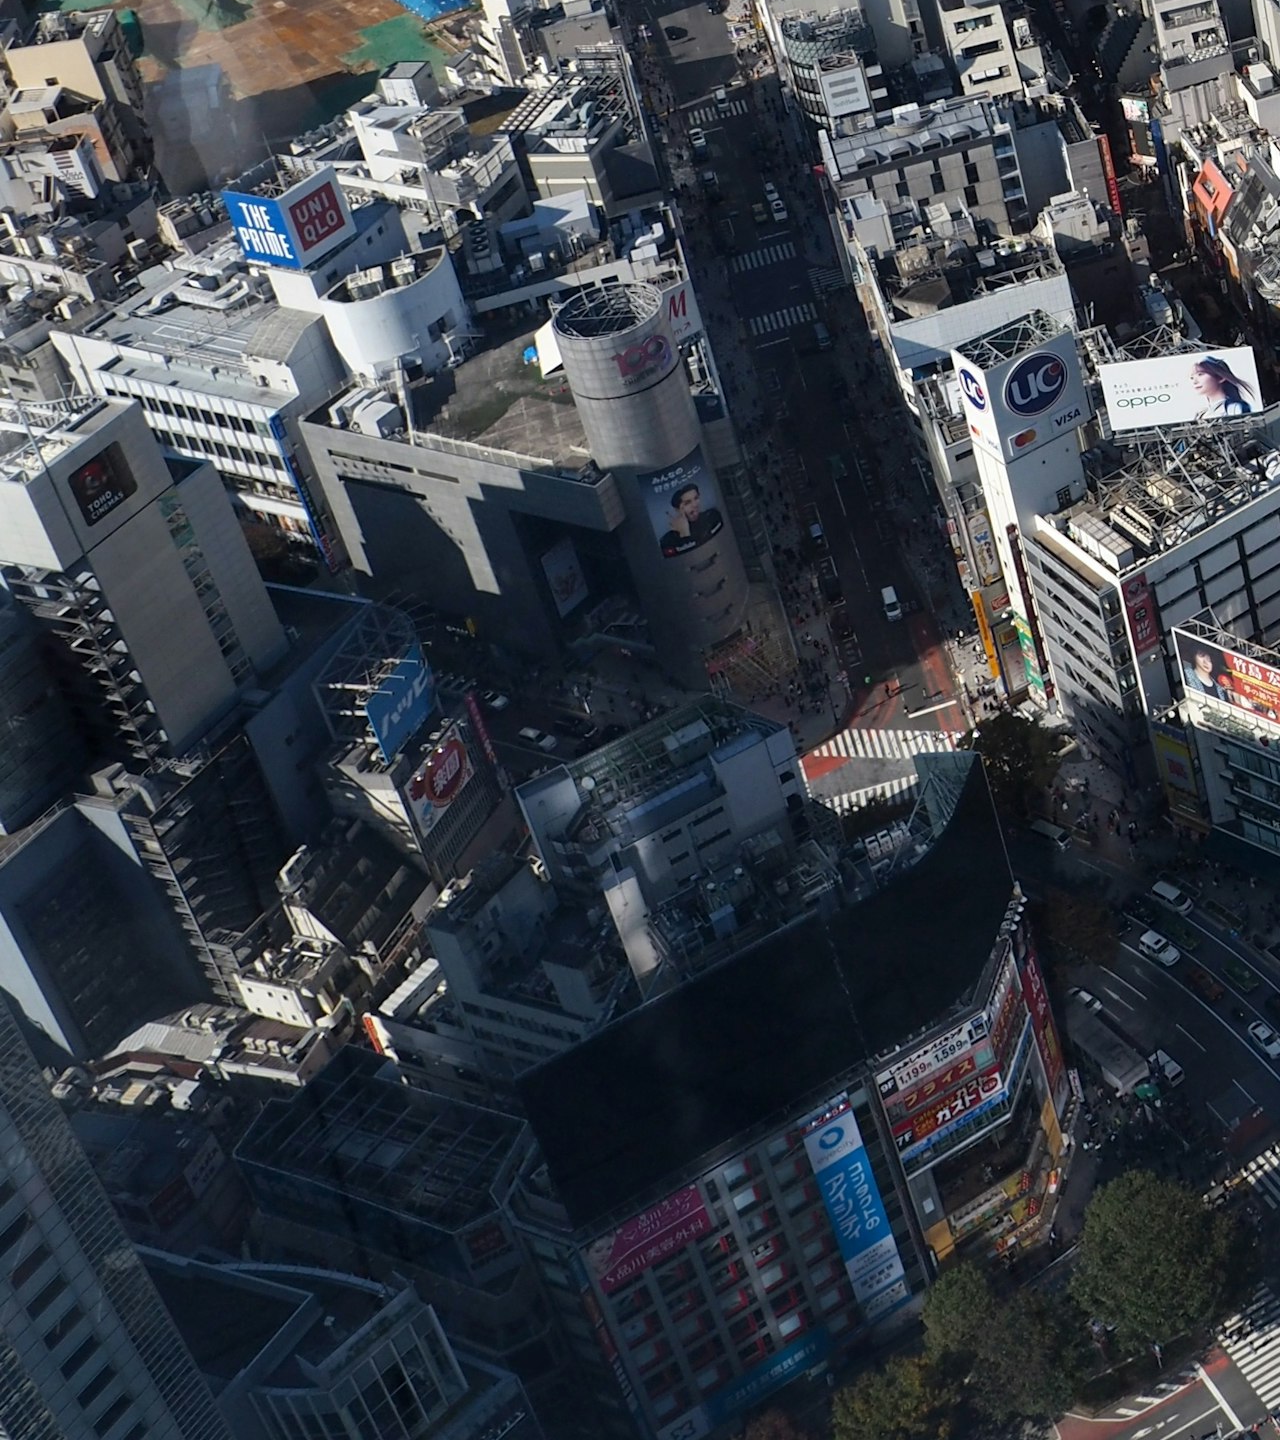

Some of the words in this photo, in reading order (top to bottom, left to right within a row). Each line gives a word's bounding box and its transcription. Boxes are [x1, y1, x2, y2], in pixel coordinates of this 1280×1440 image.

[238, 202, 275, 232] THE
[295, 191, 331, 224] UNI
[302, 209, 339, 242] QLO
[237, 226, 295, 259] PRIME
[610, 335, 672, 378] 109
[1116, 392, 1171, 409] oppo
[1054, 407, 1082, 427] VISA
[86, 490, 114, 511] TOHO
[90, 490, 125, 520] CINEMAS
[880, 1079, 895, 1094] 9F
[936, 1092, 978, 1126] ガスト
[896, 1130, 913, 1147] 7F
